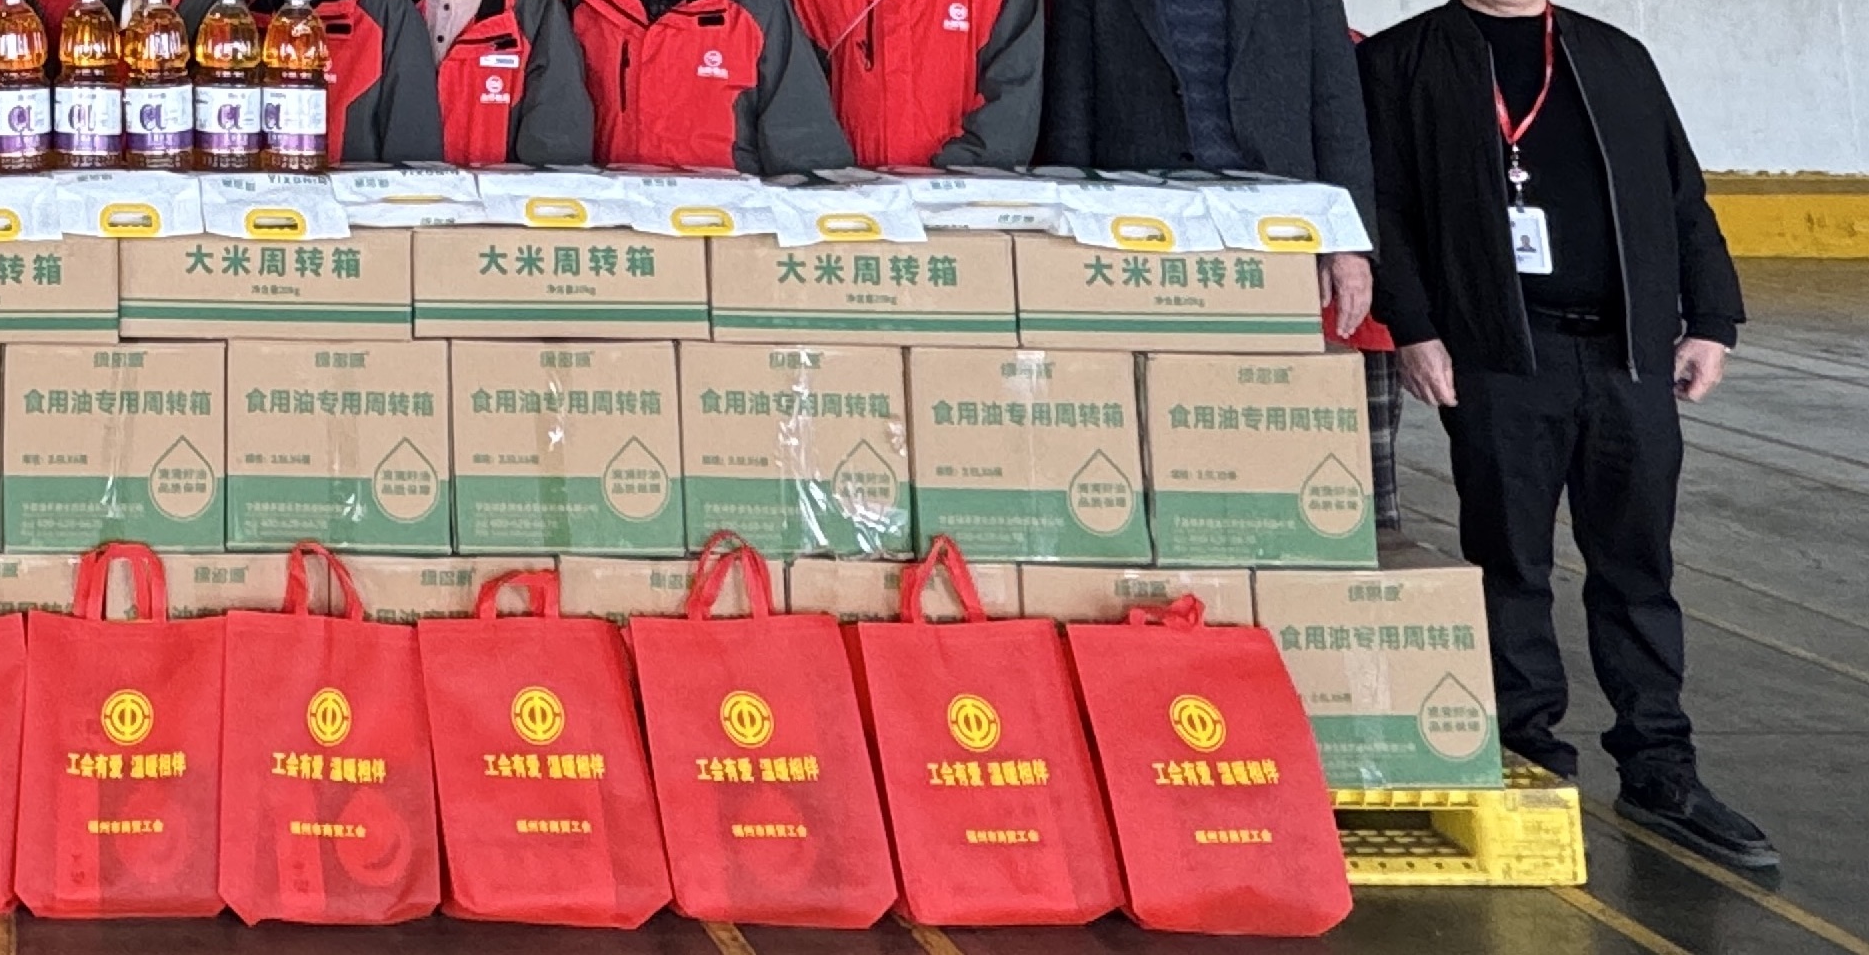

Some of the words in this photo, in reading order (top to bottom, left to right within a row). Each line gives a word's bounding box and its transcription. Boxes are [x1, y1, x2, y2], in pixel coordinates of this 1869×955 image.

[187, 247, 362, 280] 大米周转箱
[480, 245, 657, 279] 大米周转箱
[778, 254, 959, 289] 大米周转箱
[1086, 256, 1266, 290] 大米周转箱
[25, 389, 212, 415] 食用油专用周转箱
[247, 389, 435, 416] 食用油专用周转箱
[472, 390, 661, 415] 食用油专用周转箱
[934, 400, 1125, 428] 食用油专用周转箱
[1170, 405, 1357, 431] 食用油专用周转箱
[1280, 623, 1475, 651] 食用油专用周转箱
